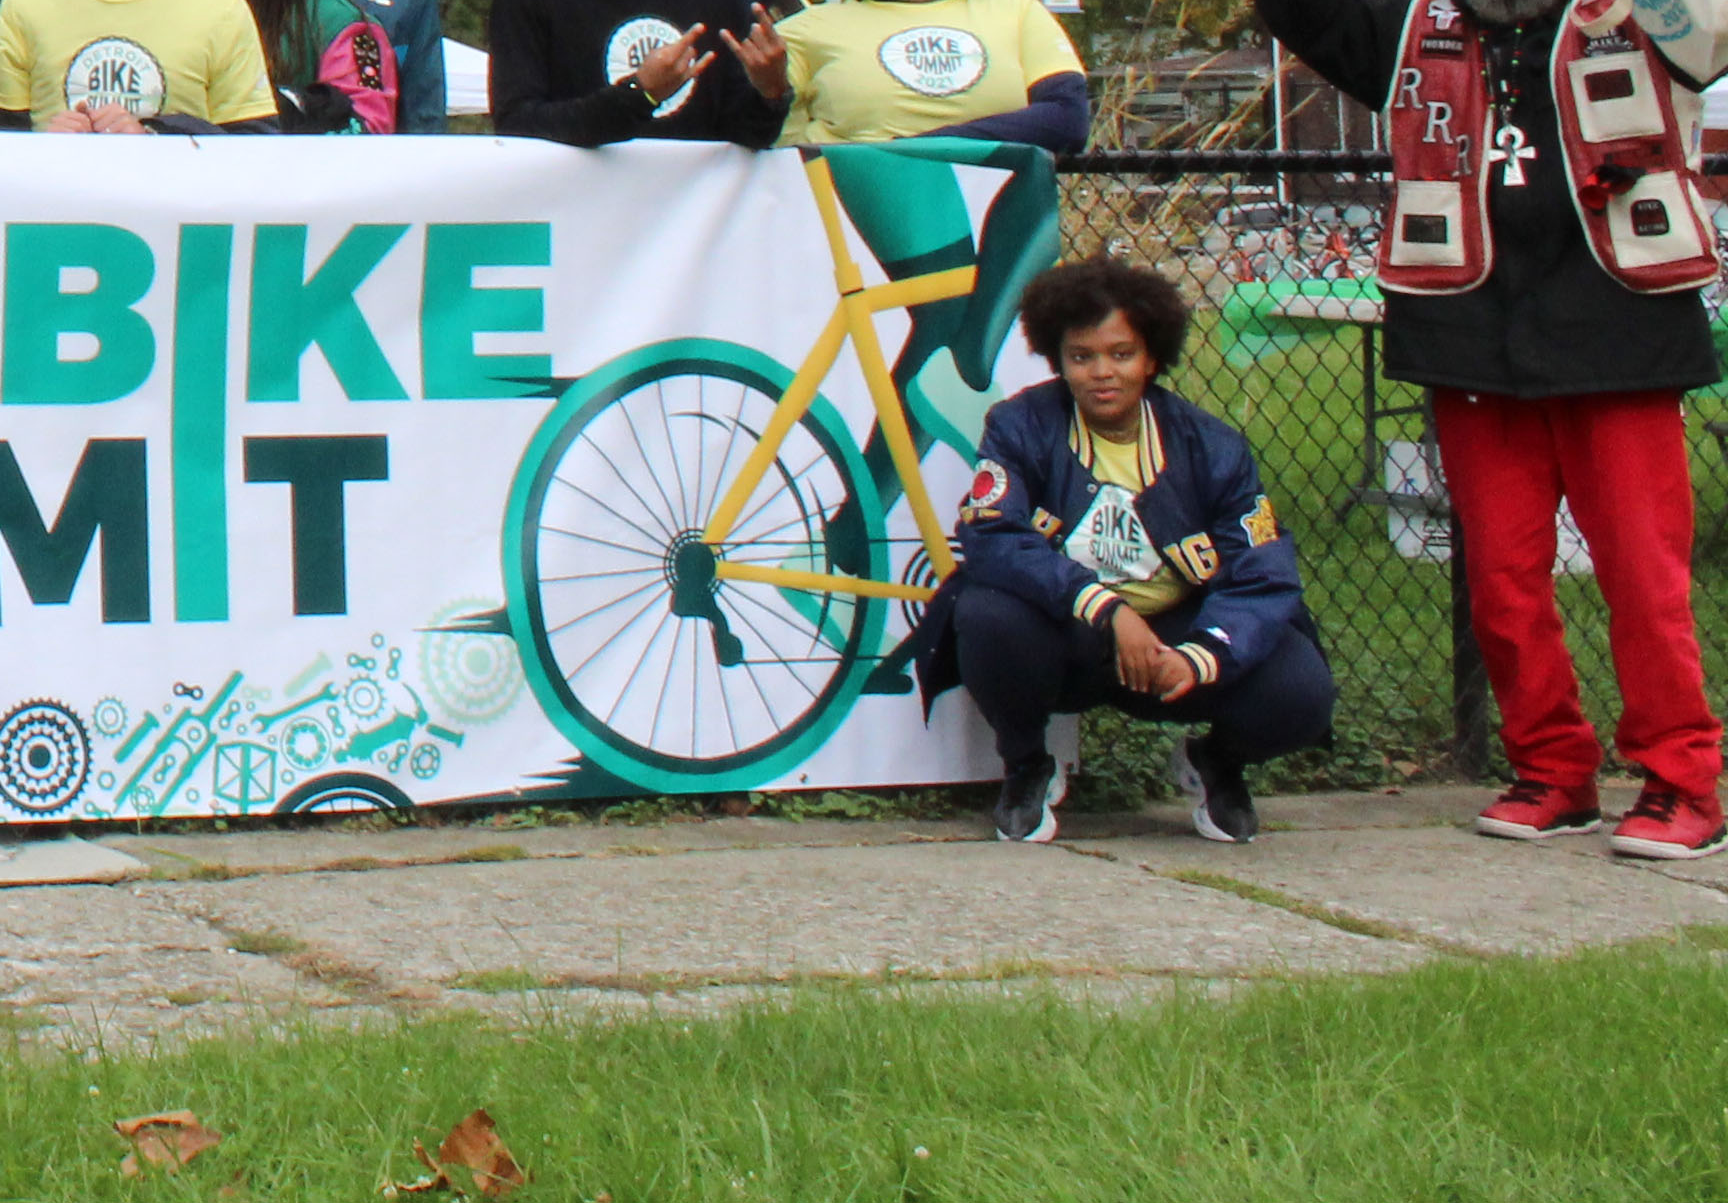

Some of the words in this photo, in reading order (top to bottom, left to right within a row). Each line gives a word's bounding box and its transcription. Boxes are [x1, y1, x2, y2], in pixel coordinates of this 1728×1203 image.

[82, 46, 153, 71] DETROIT
[905, 36, 960, 54] BIKE
[89, 59, 141, 94] BIKE
[1092, 505, 1140, 543] BIKE
